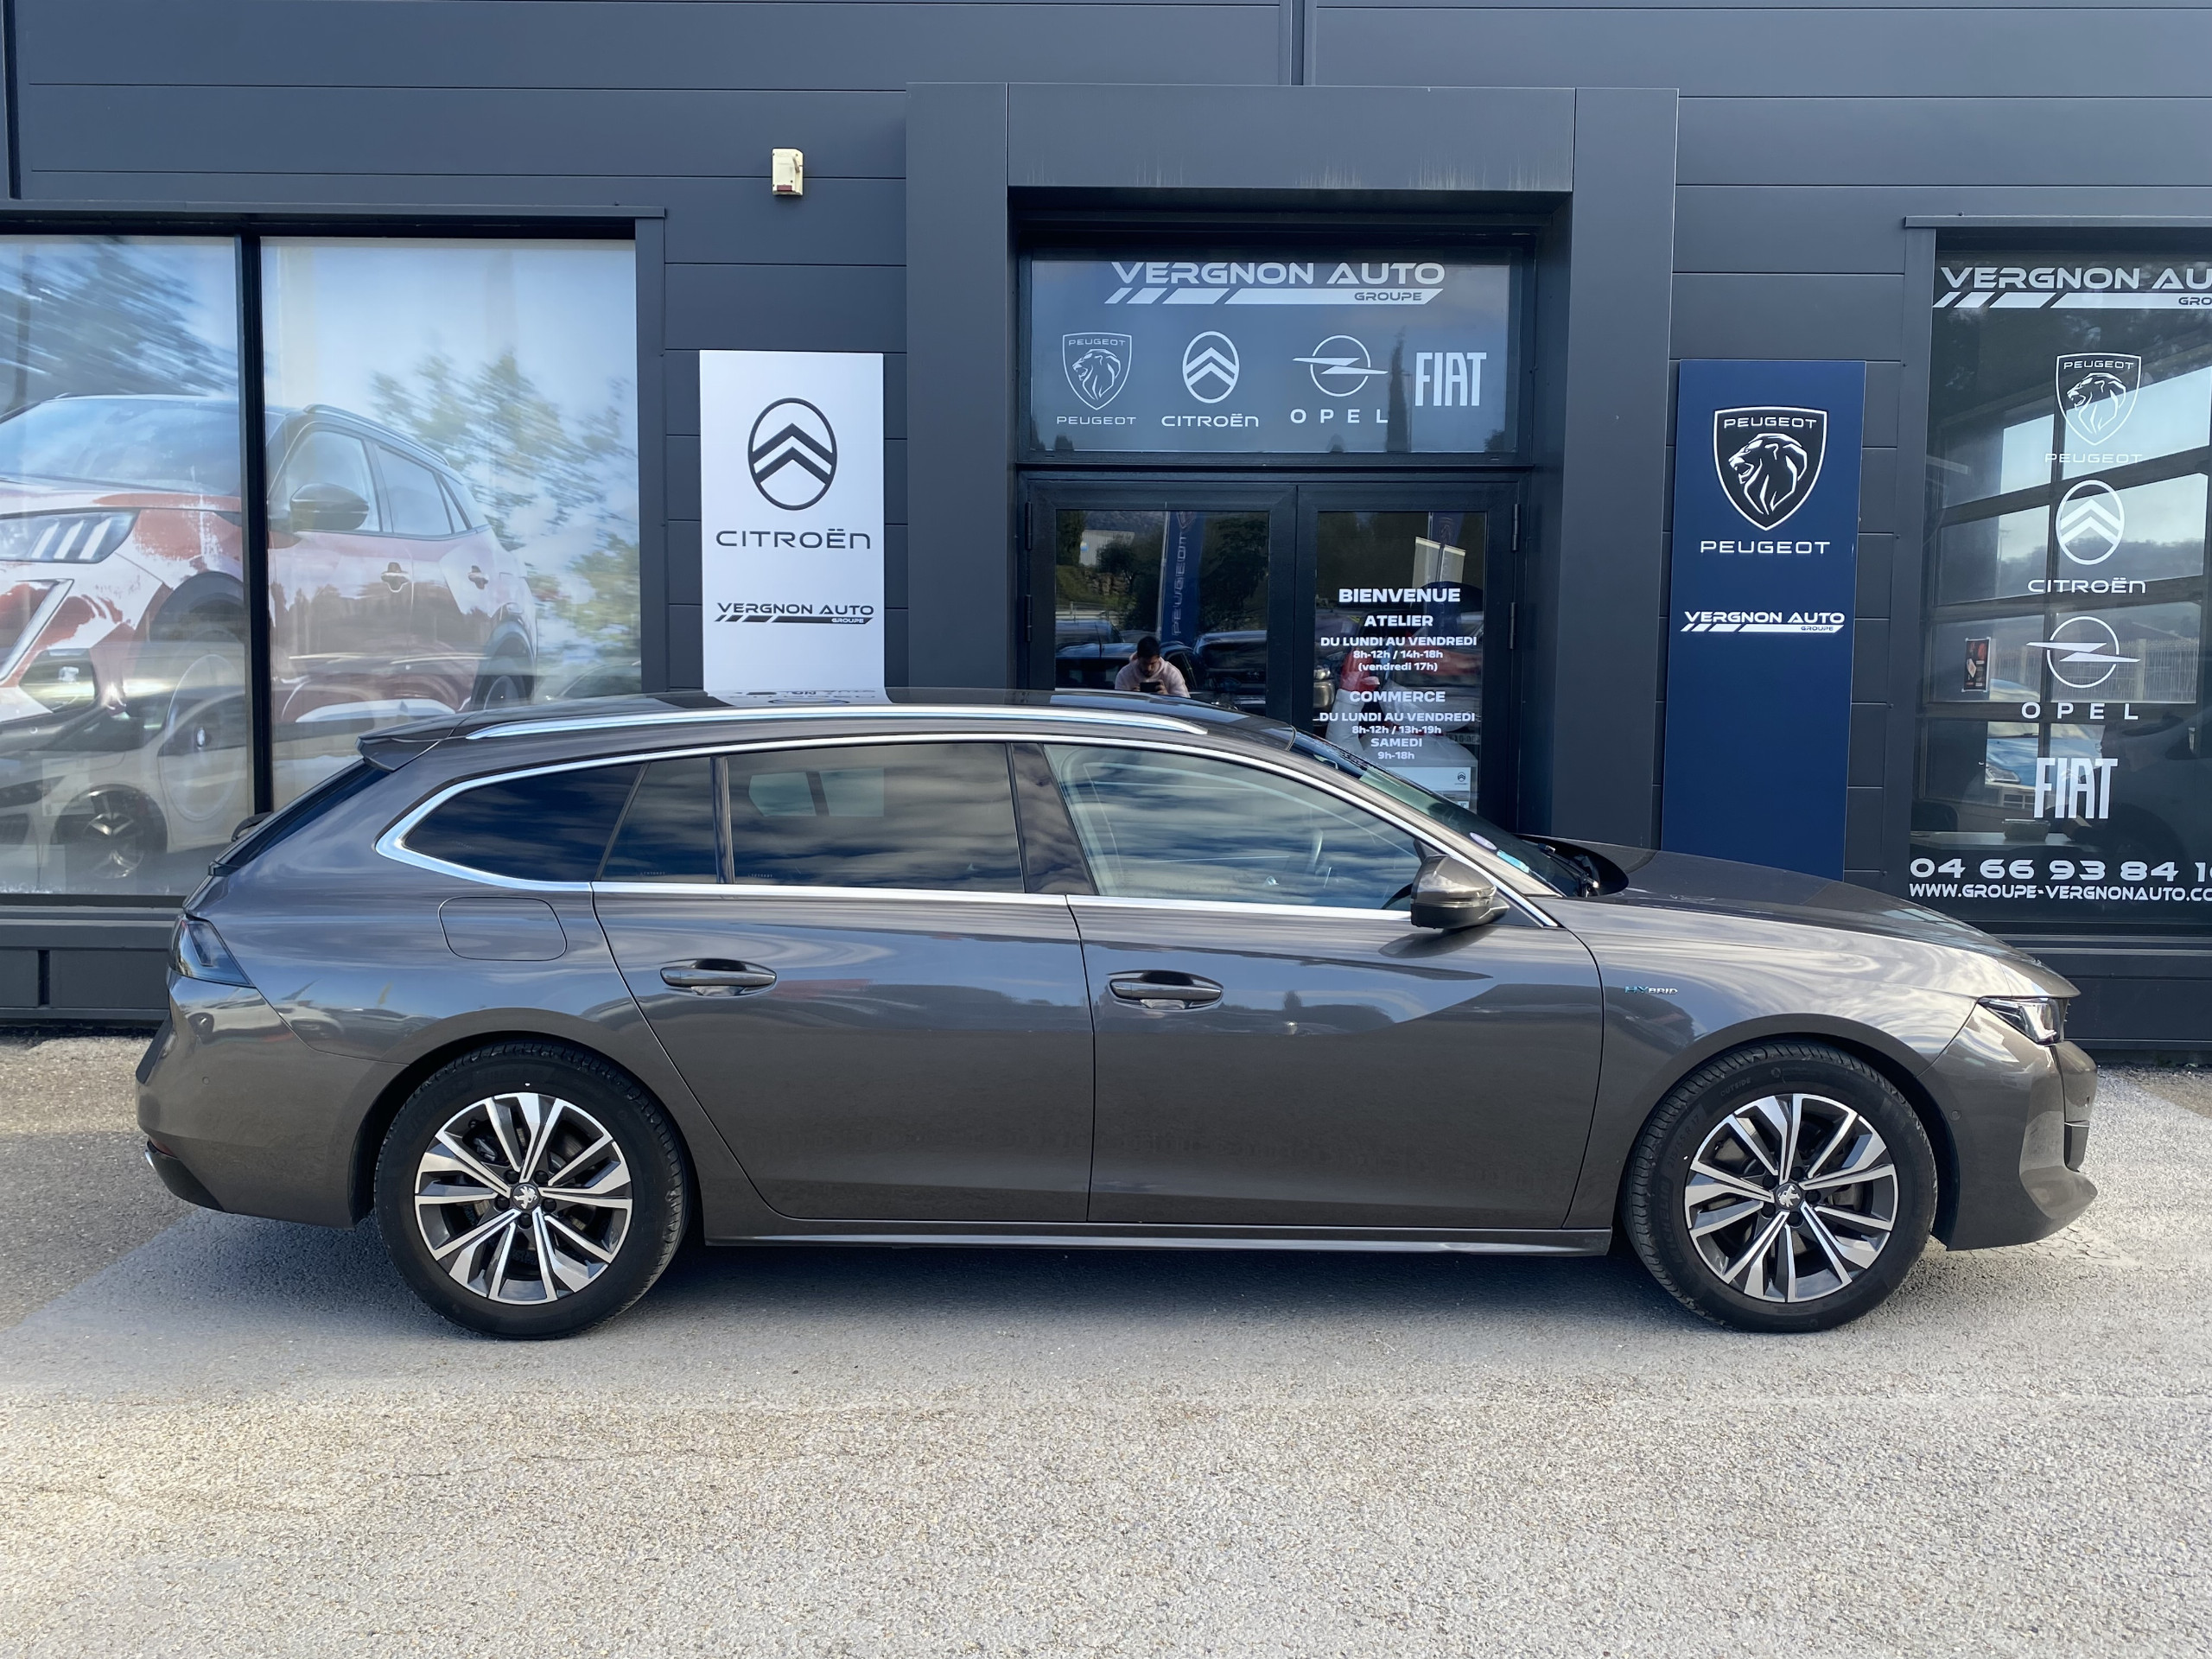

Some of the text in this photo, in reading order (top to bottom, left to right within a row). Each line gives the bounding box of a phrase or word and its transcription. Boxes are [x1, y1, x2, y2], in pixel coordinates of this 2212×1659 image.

[1111, 262, 1446, 285] VERGNON AUTO
[1941, 267, 2212, 289] VERGNON AU
[1354, 291, 1422, 302] GROUPE
[1068, 338, 1126, 347] PEUGEOT
[2063, 359, 2134, 370] PEUGEOT
[1414, 352, 1487, 407] FIAT
[1057, 416, 1136, 426] PEUGEOT
[1290, 409, 1388, 423] OPEL
[1724, 416, 1817, 429] PEUGEOT
[2045, 453, 2143, 464] PEUGEOT
[1700, 540, 1831, 554] PEUGEOT
[1338, 588, 1460, 603] BIENVENUE
[717, 602, 874, 615] VERGNON AUTO
[1363, 615, 1433, 626] ATELIER
[1684, 612, 1845, 624] VERGNON AUTO
[1320, 636, 1477, 646] DU LUNDI AU VENDREDI
[1353, 650, 1390, 658] 8h-12h
[1400, 650, 1443, 658] 14h-18h
[1357, 662, 1438, 672] (vendredi 17h)
[1350, 690, 1446, 702] COMMERCE
[2021, 702, 2139, 720] OPEL
[1319, 712, 1475, 722] DU LUNDI AU VENDREDI
[1351, 725, 1389, 734] 8h-12h
[1398, 725, 1442, 734] 13h-19h
[1370, 738, 1422, 747] SAMEDI
[1377, 751, 1415, 760] 9h-18h
[2033, 757, 2119, 819] FIAT
[1910, 858, 2212, 882] 04 66 93 84 1
[1910, 883, 2212, 901] WWW.GROUPE-VERGNONAUTO.CO
[1625, 986, 1678, 995] HYBRID
